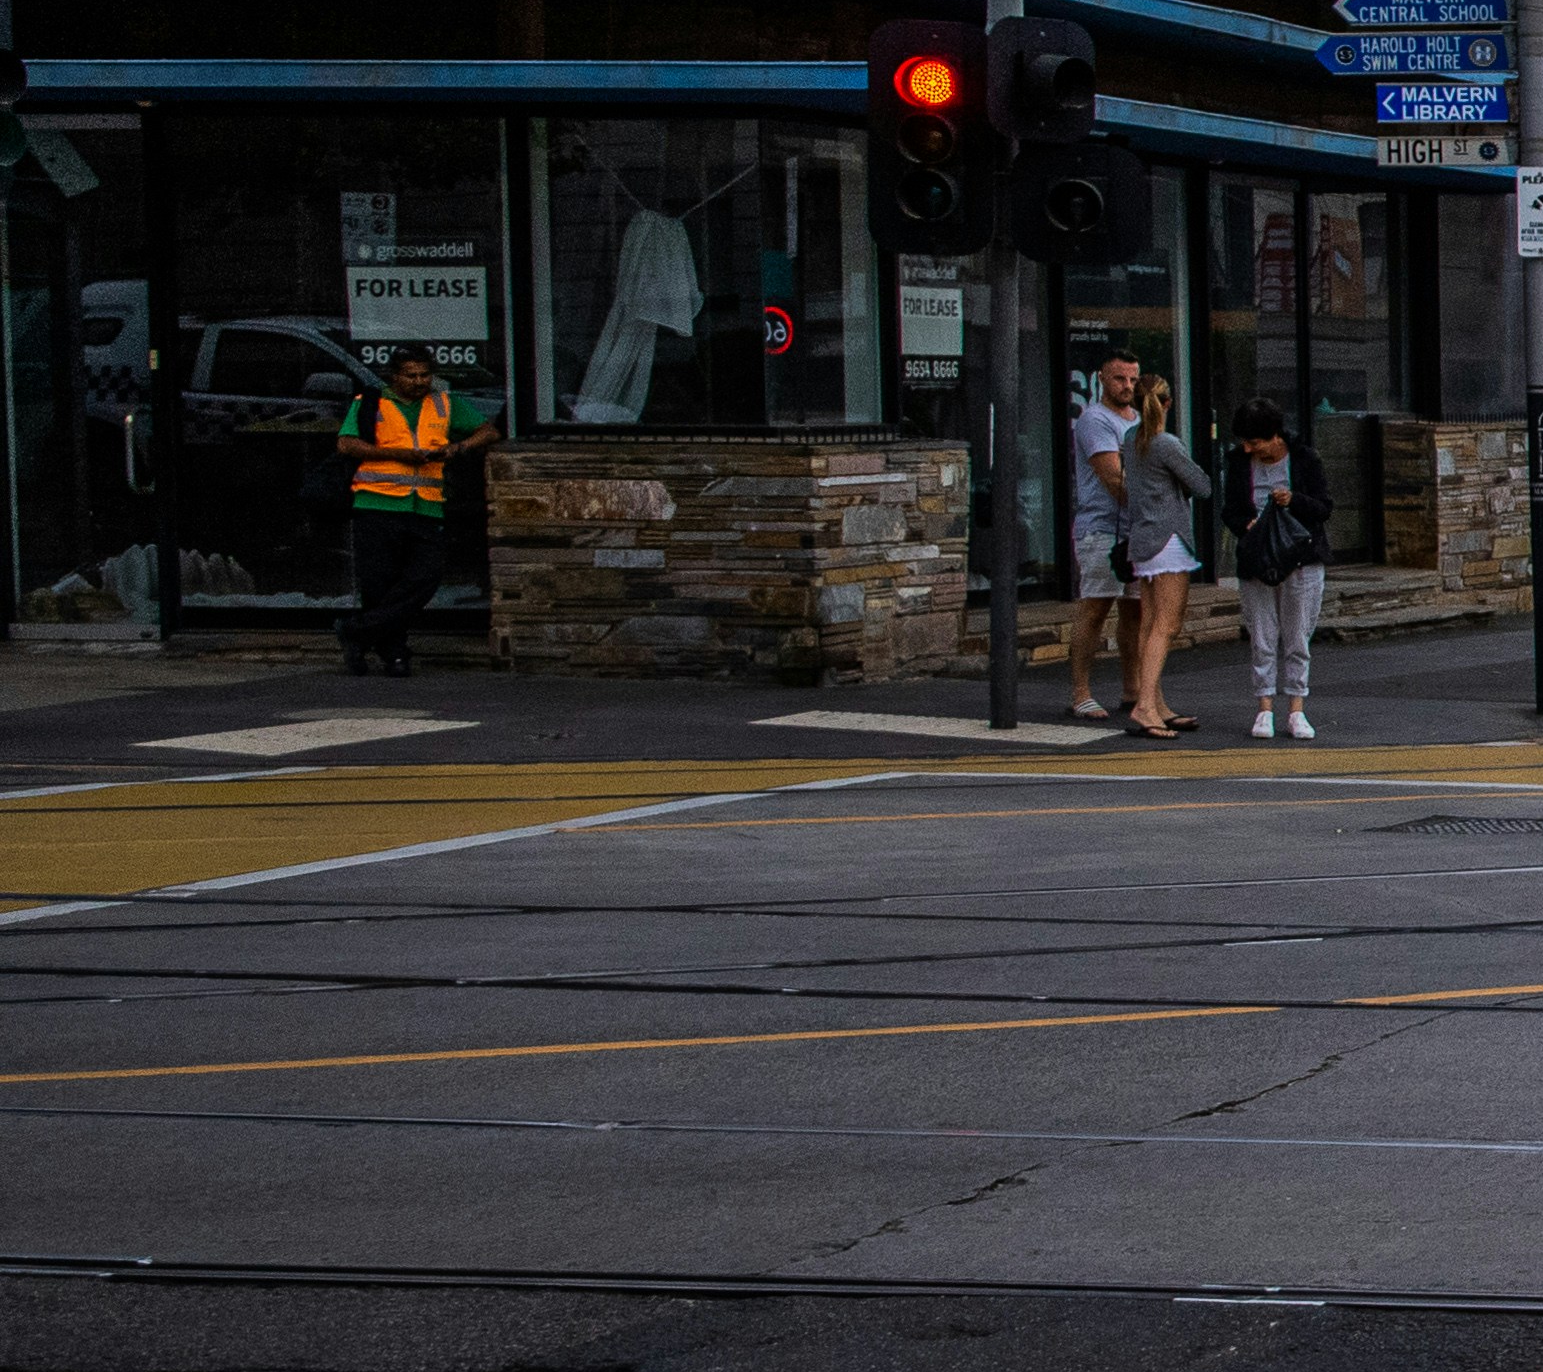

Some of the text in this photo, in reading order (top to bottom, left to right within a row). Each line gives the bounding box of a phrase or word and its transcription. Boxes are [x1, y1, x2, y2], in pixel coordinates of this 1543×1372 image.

[1359, 4, 1499, 23] CENTRAL SCHOOL
[1360, 36, 1461, 53] HAROLD HOLT
[1362, 54, 1461, 71] SWIM CENTRE
[1401, 86, 1498, 103] MALVERN
[1401, 104, 1488, 121] LIBRARY
[1387, 139, 1469, 164] HIGH ST
[376, 242, 474, 261] grosswaddell
[356, 279, 479, 298] FOR LEASE
[903, 298, 959, 317] FOR LEASE
